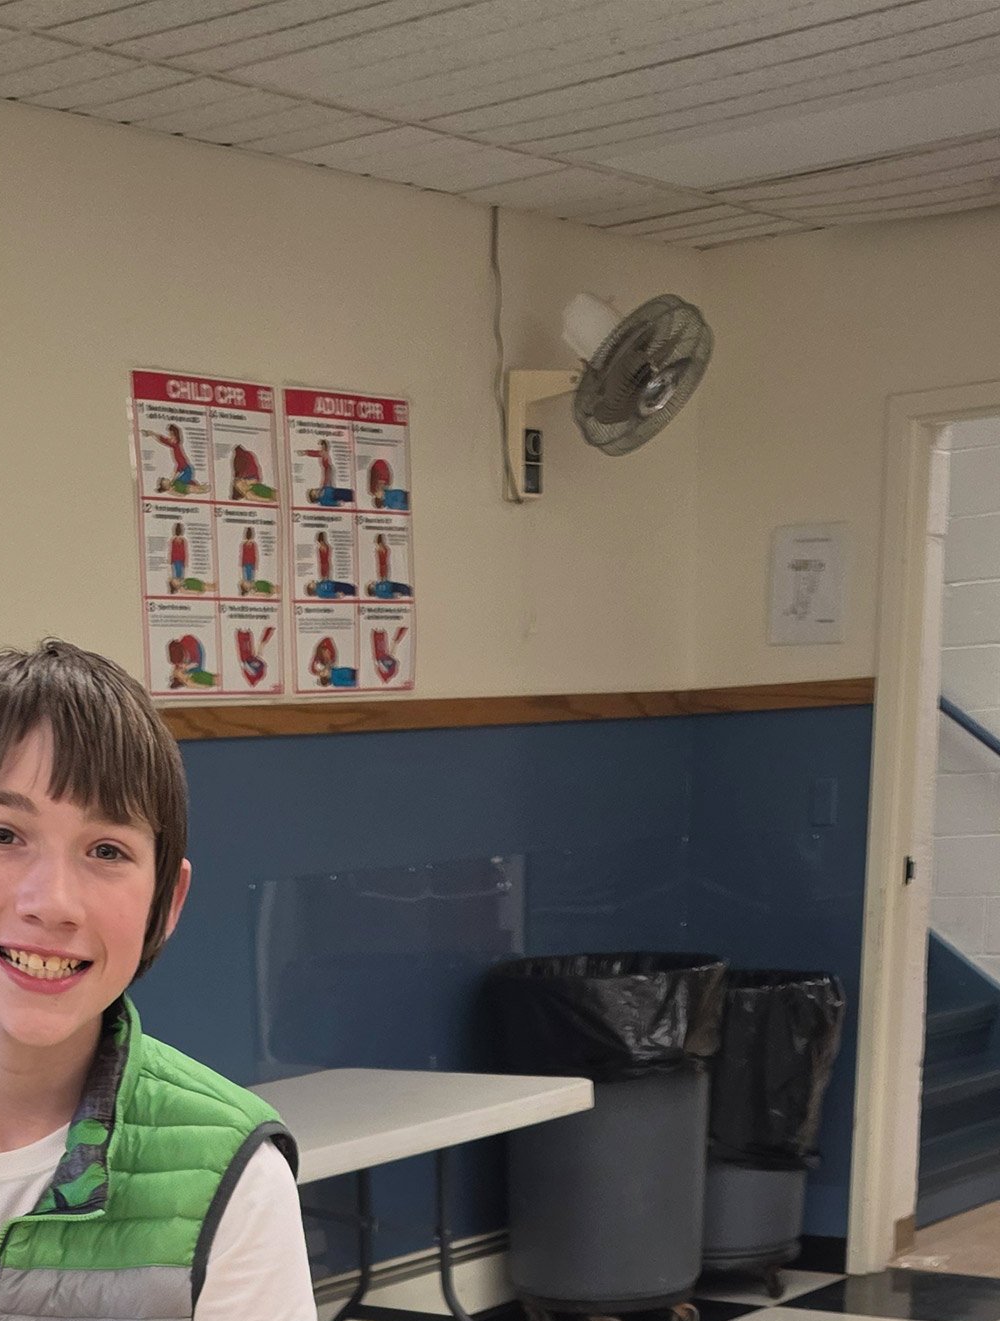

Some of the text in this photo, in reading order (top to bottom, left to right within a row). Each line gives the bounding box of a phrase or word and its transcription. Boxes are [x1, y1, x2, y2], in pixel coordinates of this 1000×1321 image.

[165, 379, 214, 402] CHILD
[214, 385, 247, 407] CPR
[313, 396, 356, 417] ADULT
[356, 400, 385, 420] CPR
